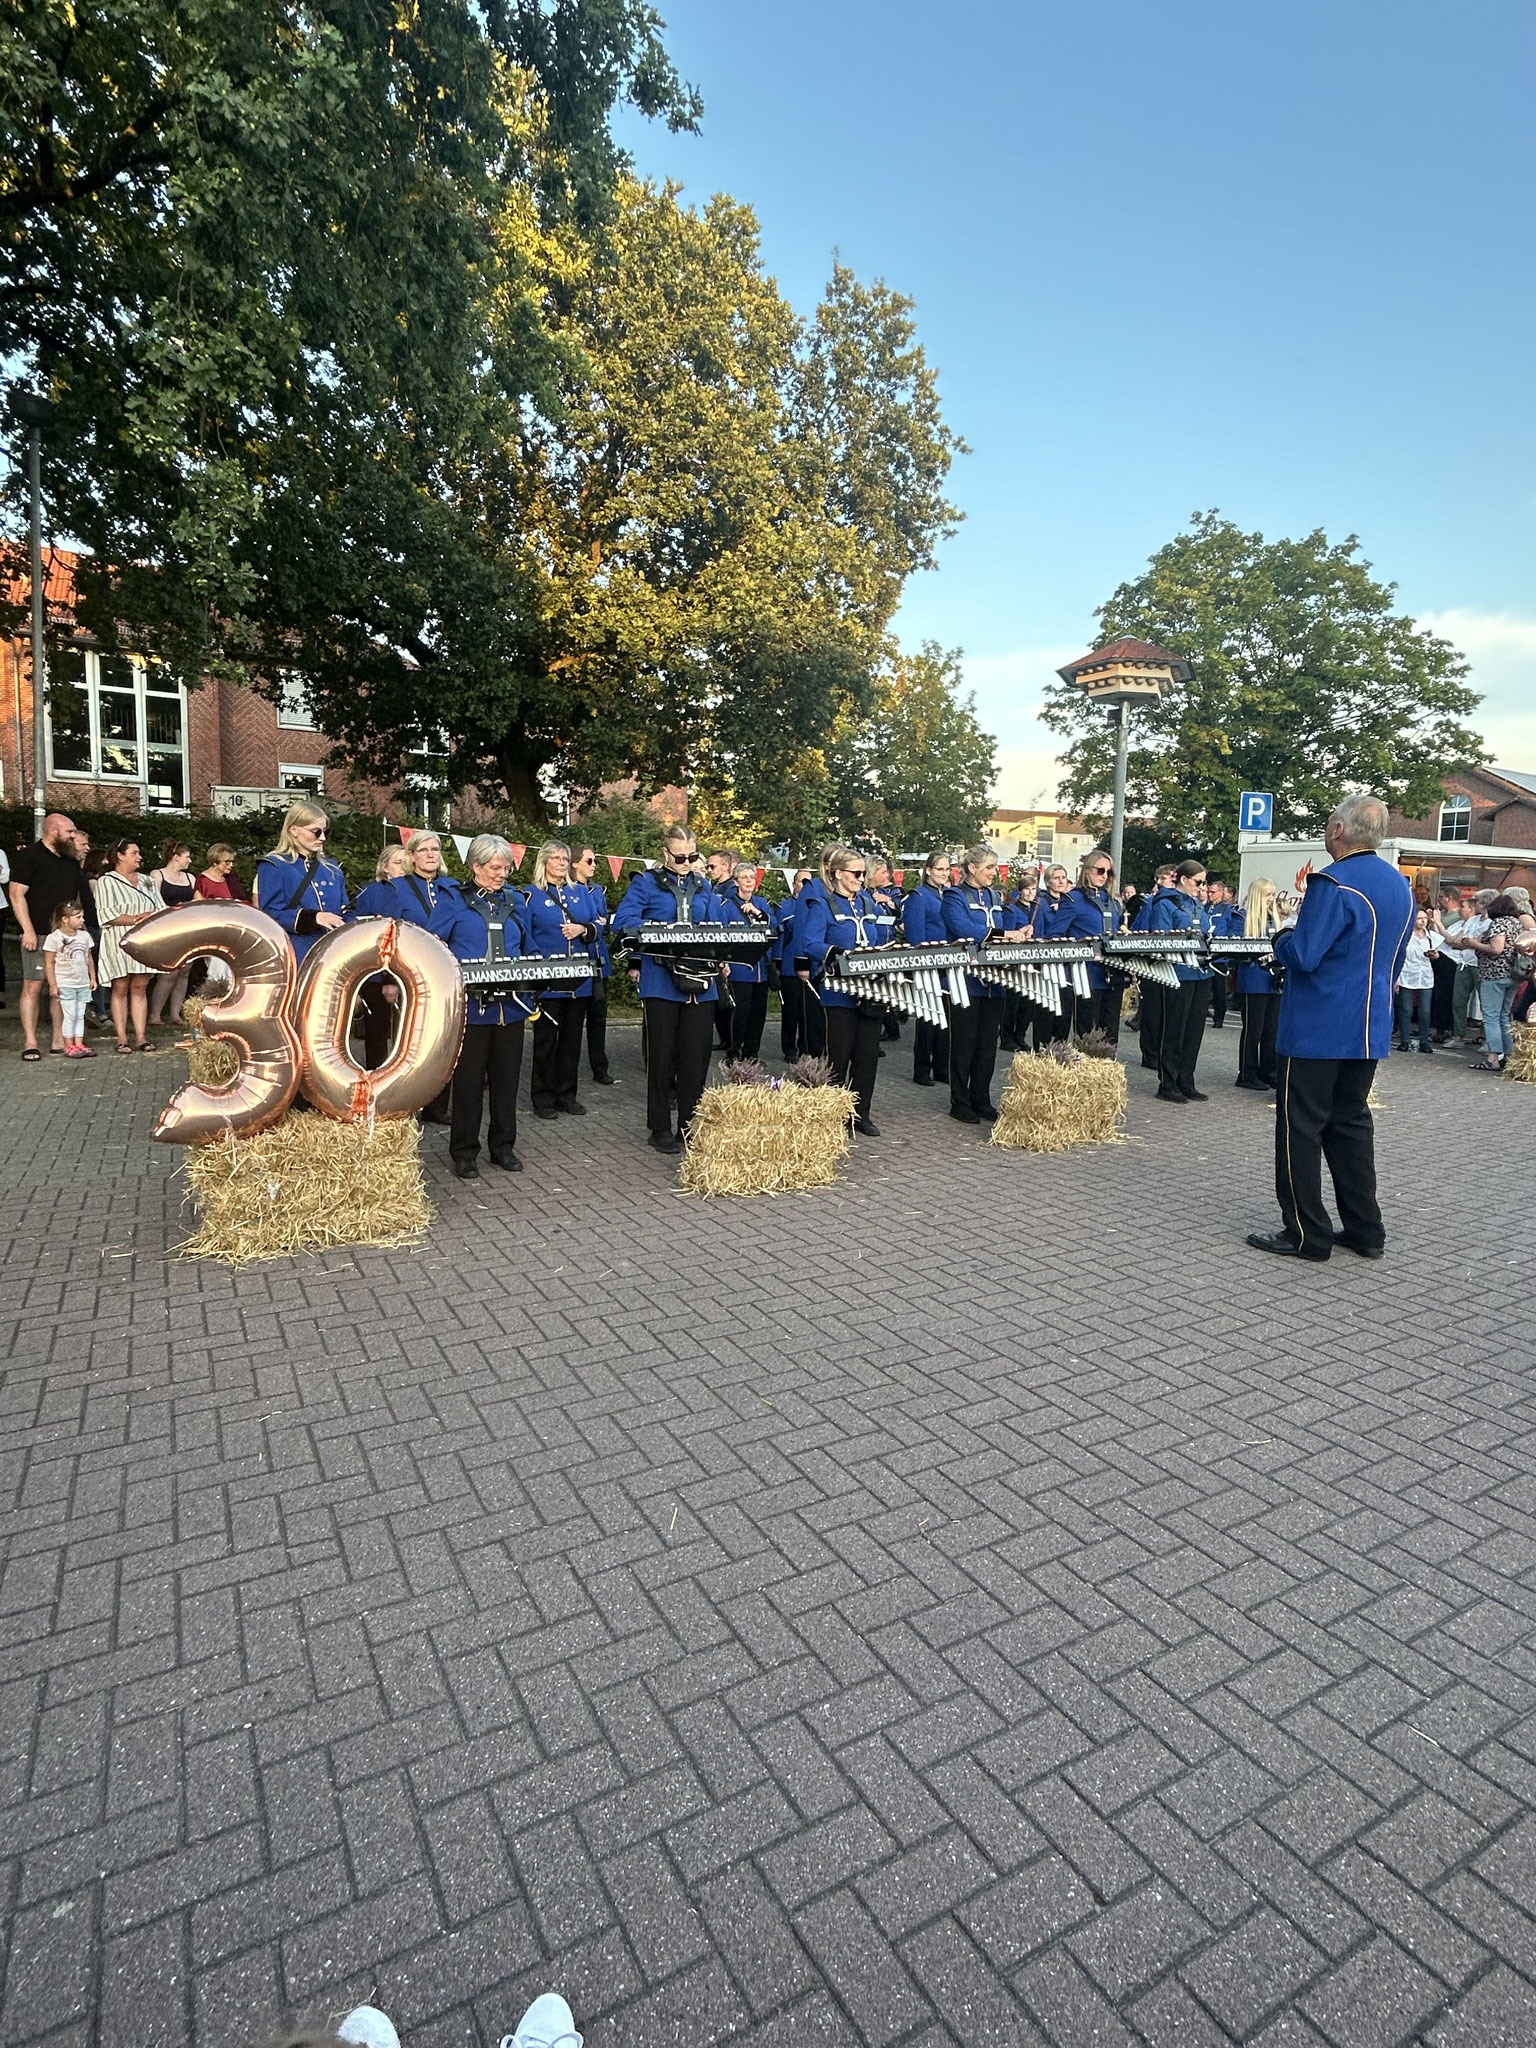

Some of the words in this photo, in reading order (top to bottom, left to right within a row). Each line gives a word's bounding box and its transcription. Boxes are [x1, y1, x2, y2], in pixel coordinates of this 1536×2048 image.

[1247, 797, 1265, 826] P
[641, 932, 703, 944] SPIELMANNSZUG
[703, 932, 766, 943] SCHNEVERDINGEN
[1109, 939, 1154, 950] SPIELMANNSZUG
[1154, 939, 1201, 949] SCHNEVERDINGEN
[848, 955, 910, 972] SPIELMANNSZUG
[909, 953, 971, 967] SCHNEVERDINGEN
[986, 948, 1040, 961] SPIELMANNSZUG
[1040, 947, 1095, 959] SCHNEVERDINGEN
[463, 968, 522, 983] ELMANNSZUG
[522, 965, 594, 980] SCHNEVERDINGEN
[119, 899, 467, 1144] 30
